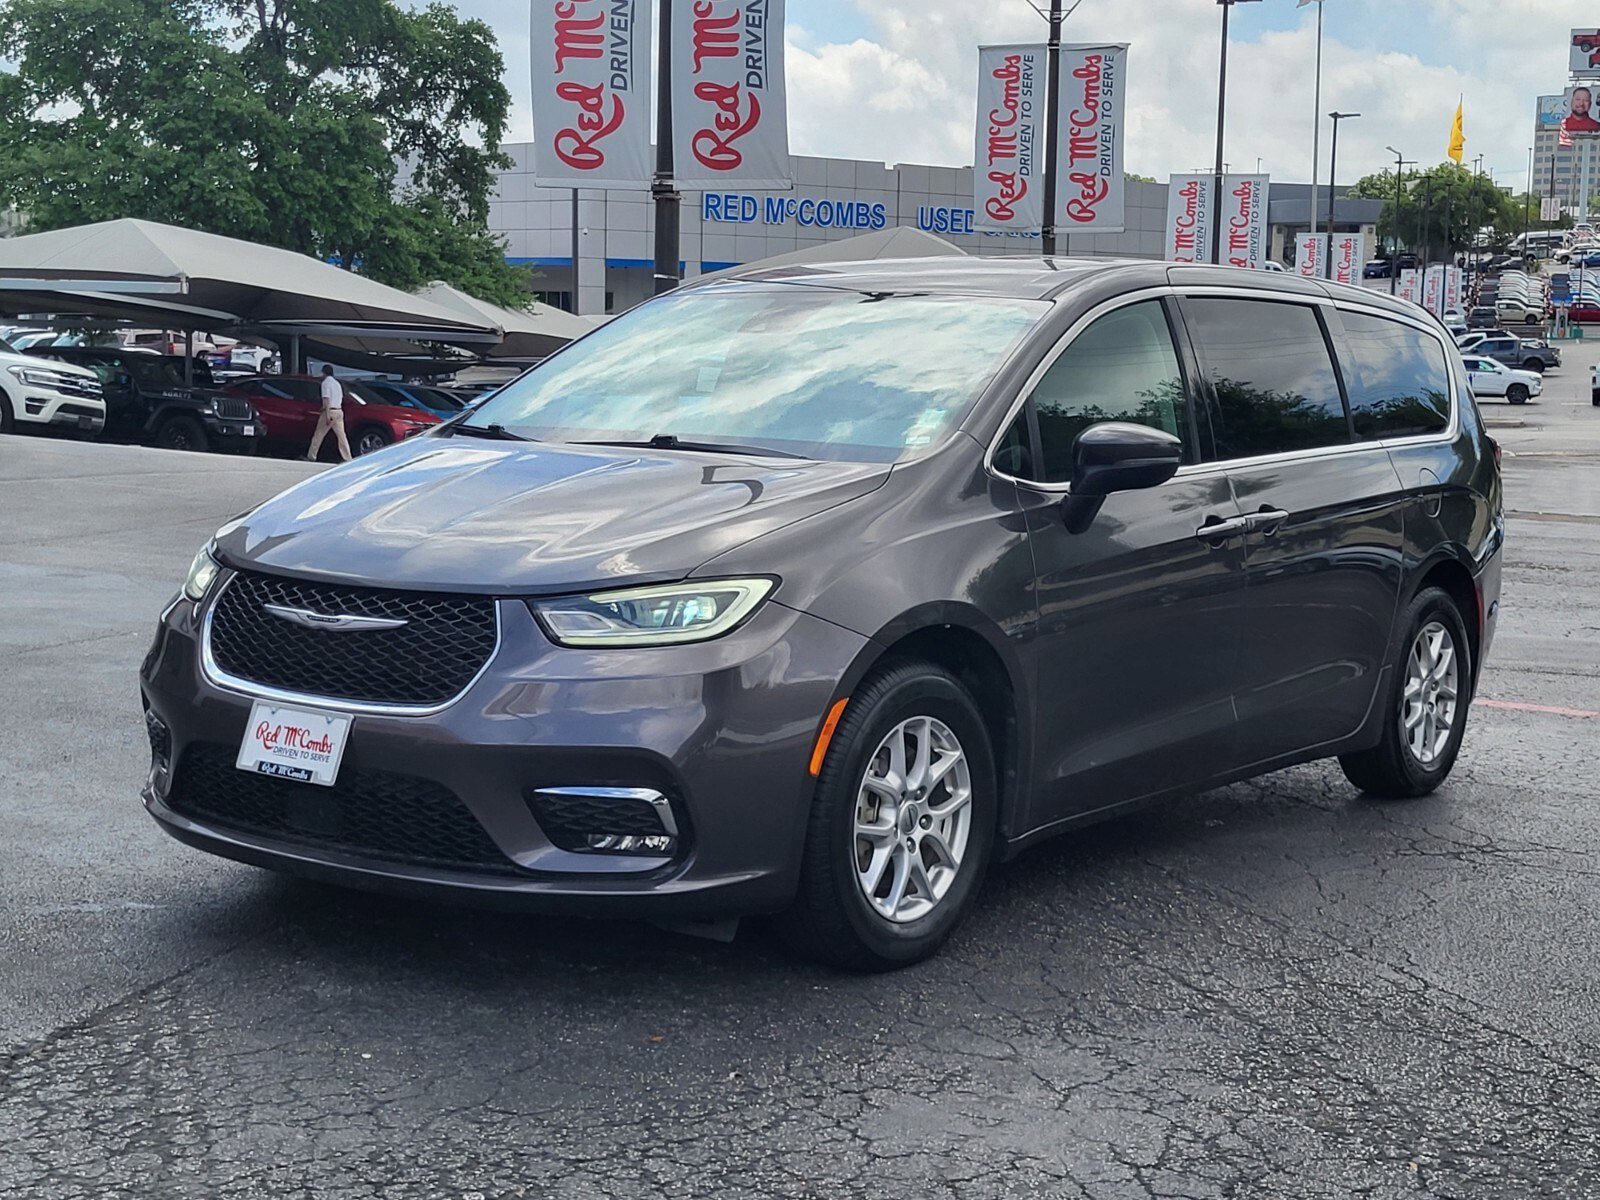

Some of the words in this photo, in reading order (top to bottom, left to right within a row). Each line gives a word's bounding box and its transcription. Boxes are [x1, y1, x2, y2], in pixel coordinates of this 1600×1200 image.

[1022, 54, 1034, 97] SERVE
[1102, 54, 1115, 97] SERVE
[554, 81, 625, 170] Red
[691, 80, 762, 171] Red
[987, 54, 1022, 169] McCombs
[1021, 102, 1032, 120] TO
[1068, 54, 1102, 169] McCombs
[1101, 101, 1113, 119] TO
[1018, 124, 1032, 177] DRIVEN
[1100, 124, 1113, 177] DRIVEN
[704, 193, 758, 222] RED
[919, 206, 975, 235] USED
[985, 171, 1027, 222] Red
[1066, 172, 1108, 223] Red
[1198, 180, 1207, 209] SERVE
[1251, 180, 1261, 209] SERVE
[1174, 181, 1198, 254] McCombs
[1197, 211, 1205, 223] TO
[1228, 181, 1252, 254] McCombs
[1250, 212, 1259, 223] TO
[1195, 227, 1205, 261] DRIVEN
[1249, 227, 1258, 261] DRIVEN
[256, 720, 282, 750] Red
[284, 725, 333, 754] McCombs
[273, 745, 298, 757] DRIVEN
[300, 751, 309, 759] TO
[310, 752, 331, 763] SERVE
